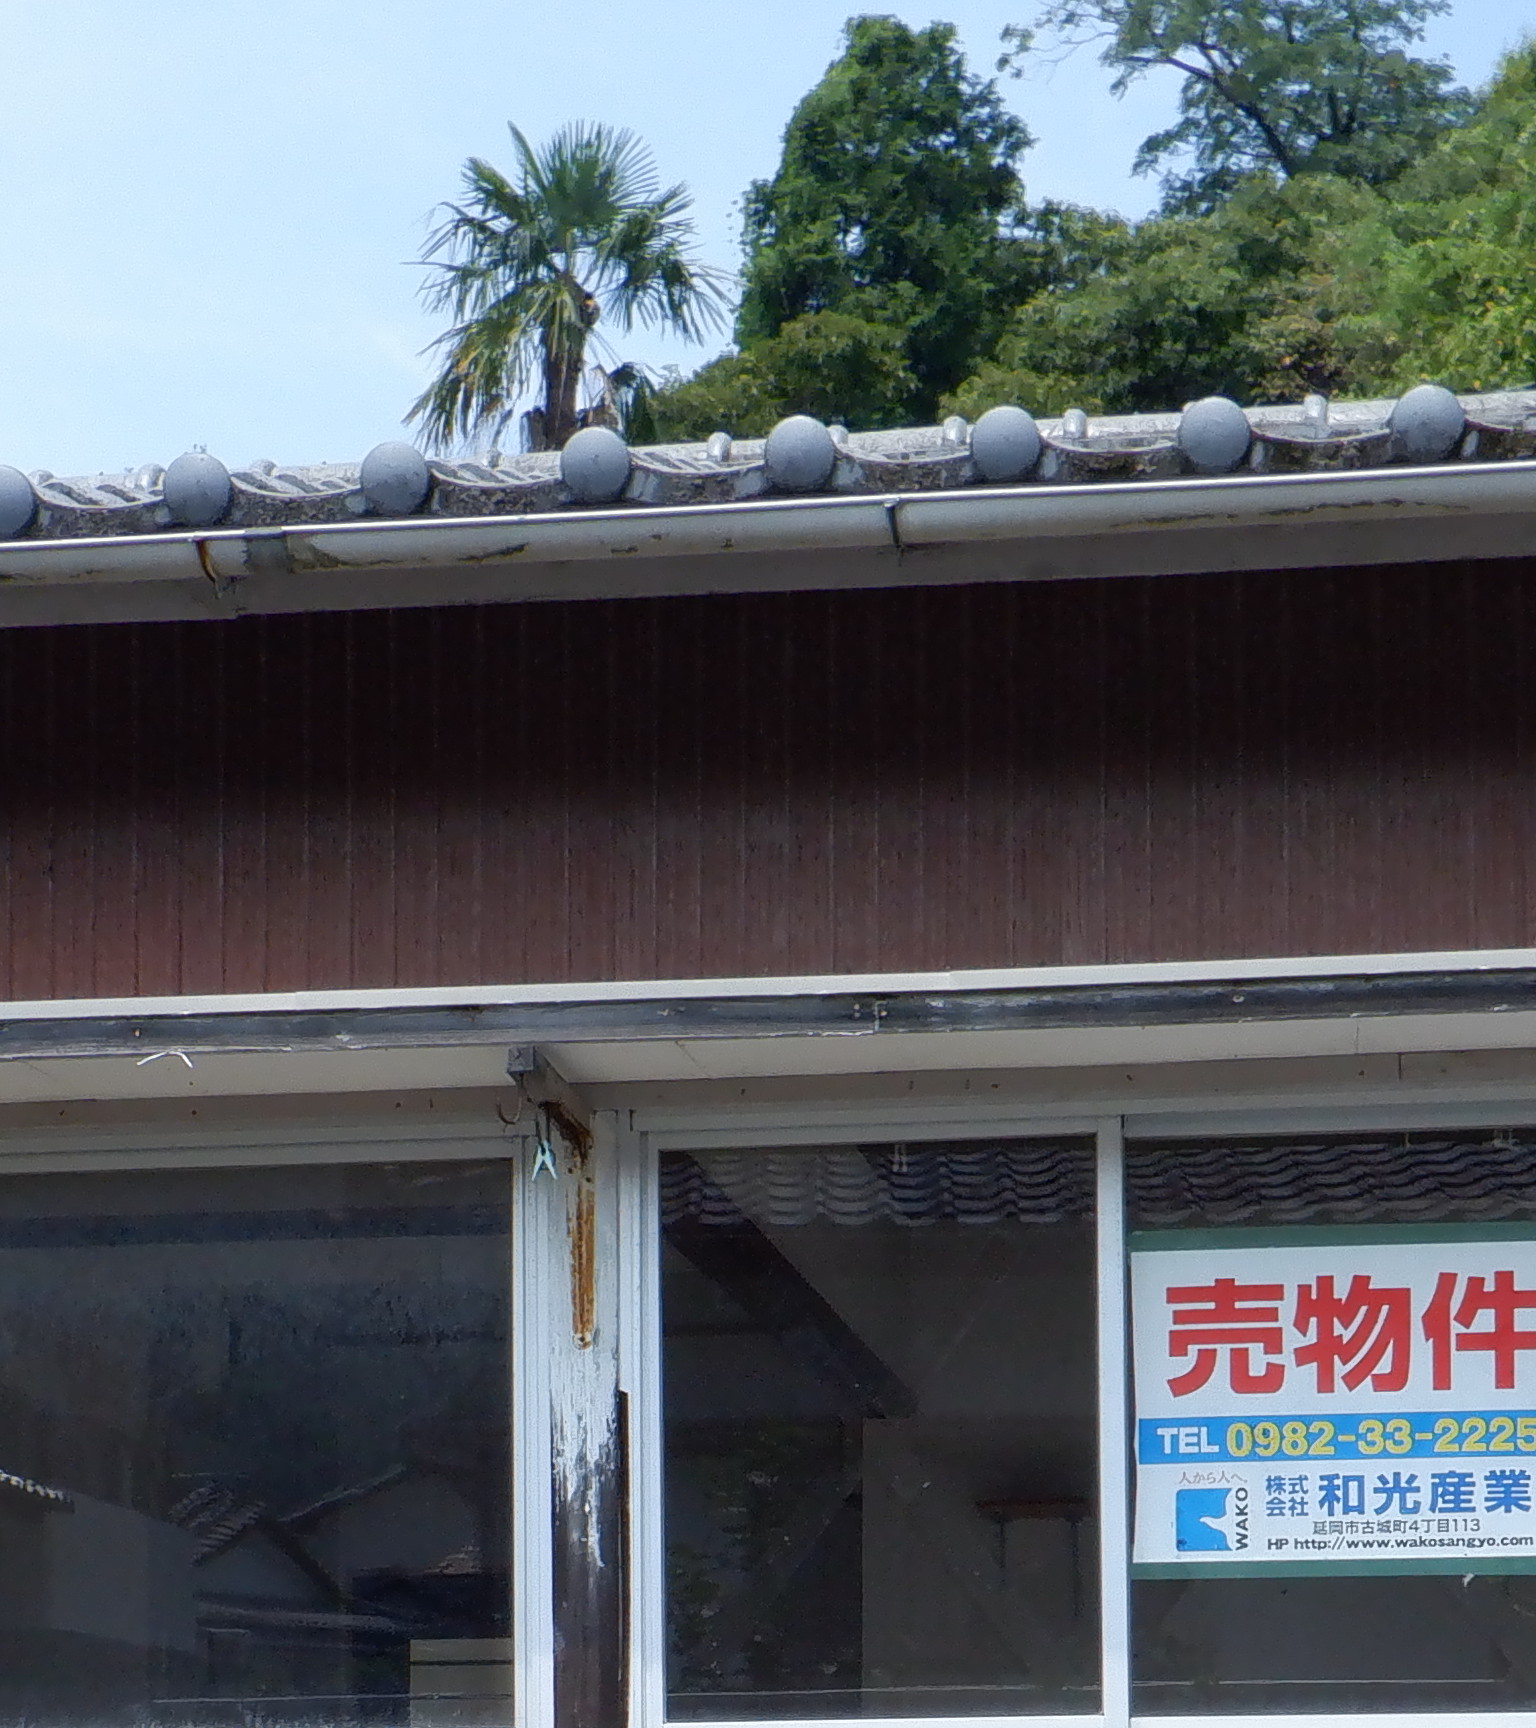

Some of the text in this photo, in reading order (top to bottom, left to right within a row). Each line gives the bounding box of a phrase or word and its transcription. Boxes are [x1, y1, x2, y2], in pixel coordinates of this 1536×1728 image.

[1156, 1426, 1220, 1455] TEL
[1317, 1468, 1533, 1517] 和光産業
[1234, 1486, 1249, 1551] WAKO
[1312, 1518, 1481, 1536] 延岡市古城町4丁目113
[1266, 1534, 1535, 1552] HP http://www.wakosangyo.com
